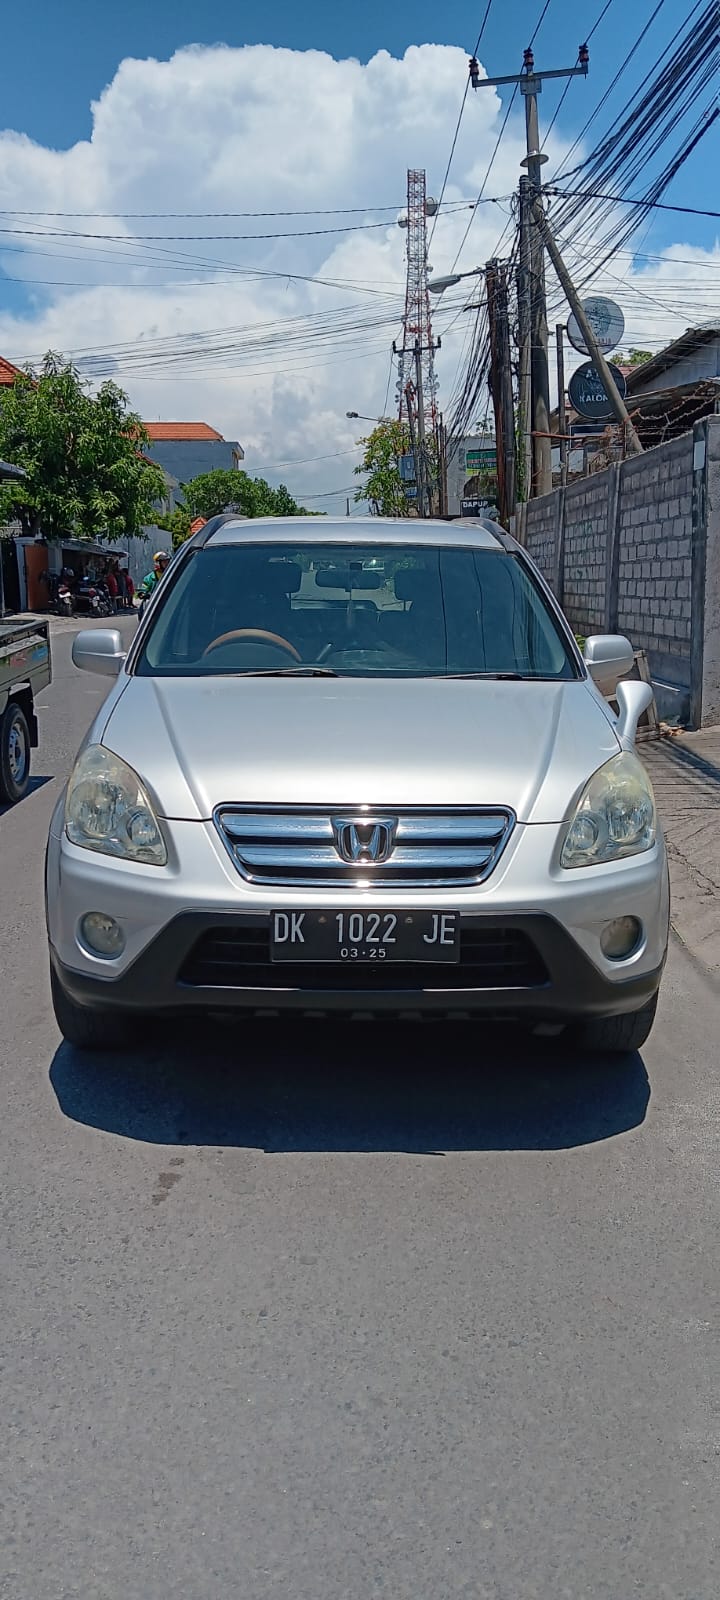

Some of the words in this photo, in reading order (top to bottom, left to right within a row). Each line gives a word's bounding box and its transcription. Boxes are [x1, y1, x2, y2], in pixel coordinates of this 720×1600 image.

[274, 913, 305, 943] DK
[335, 913, 397, 943] 1022
[423, 914, 456, 945] JE
